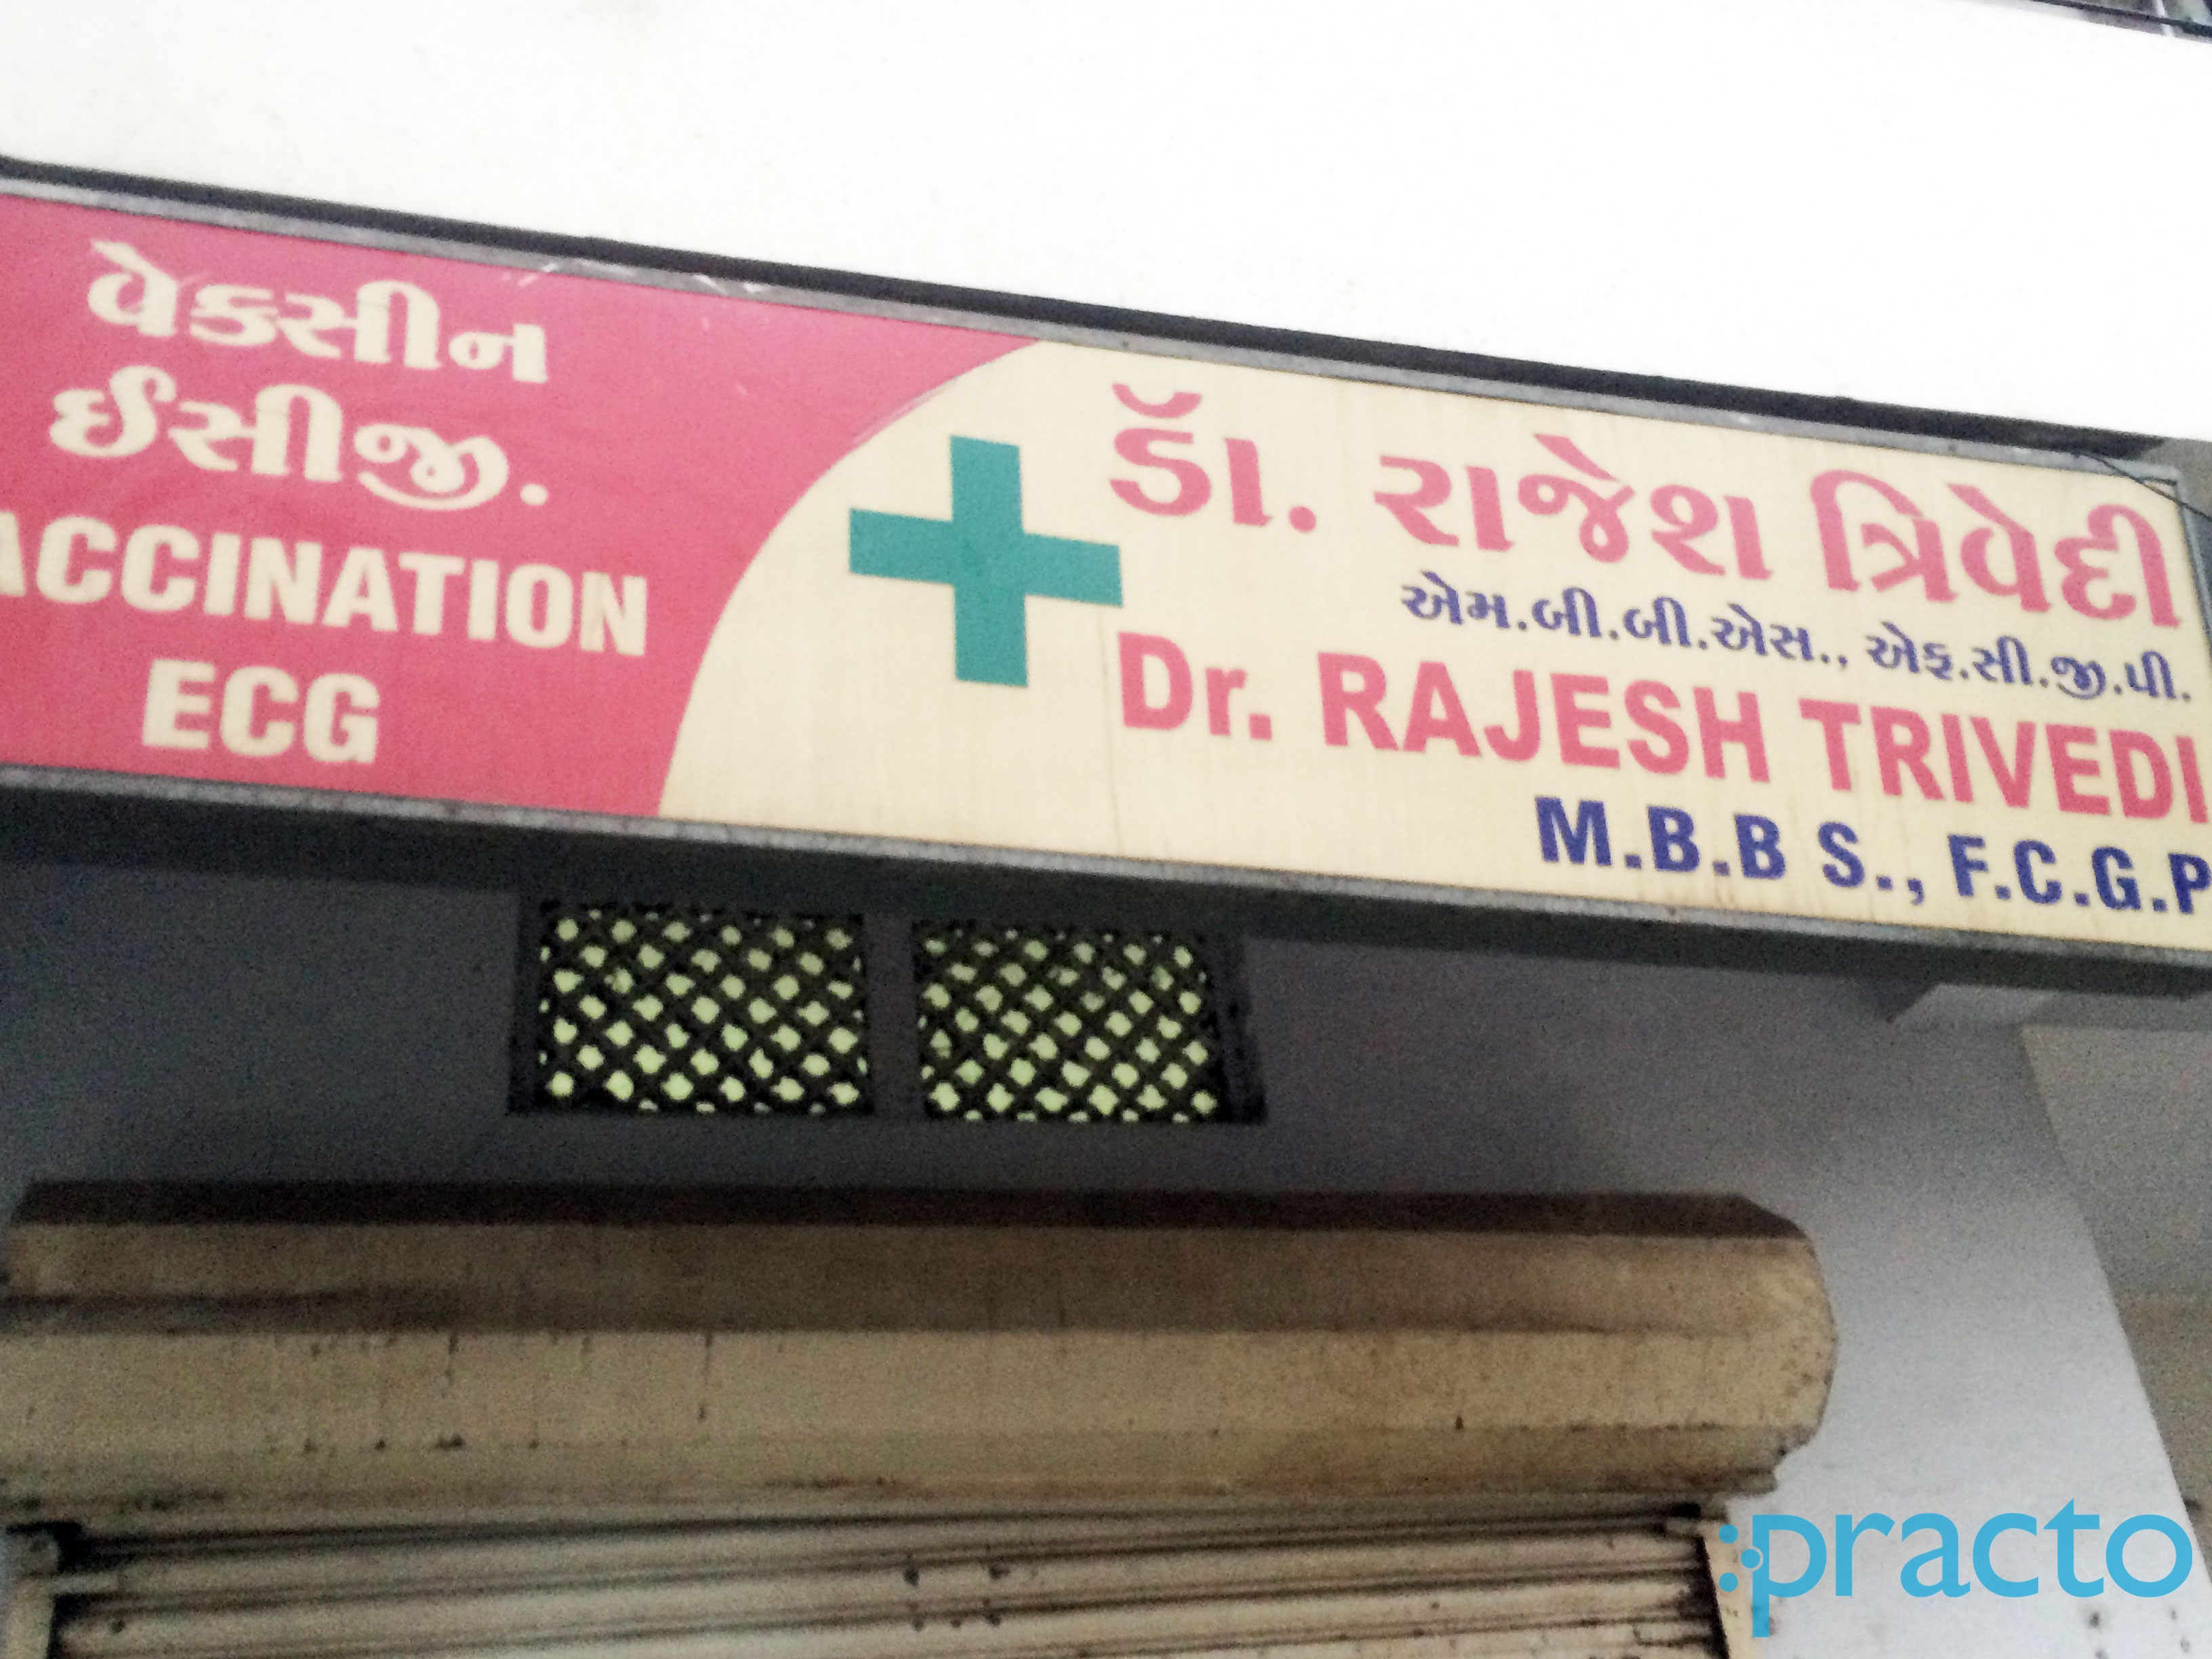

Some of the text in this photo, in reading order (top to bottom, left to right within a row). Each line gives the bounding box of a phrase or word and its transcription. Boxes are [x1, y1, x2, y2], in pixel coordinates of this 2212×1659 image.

[1374, 433, 1771, 580] રાજેશ
[1809, 469, 2182, 630] ત્રિવેદી
[142, 659, 380, 763] ECG
[1118, 632, 2211, 825] Dr. RAJESH TRIVEDI
